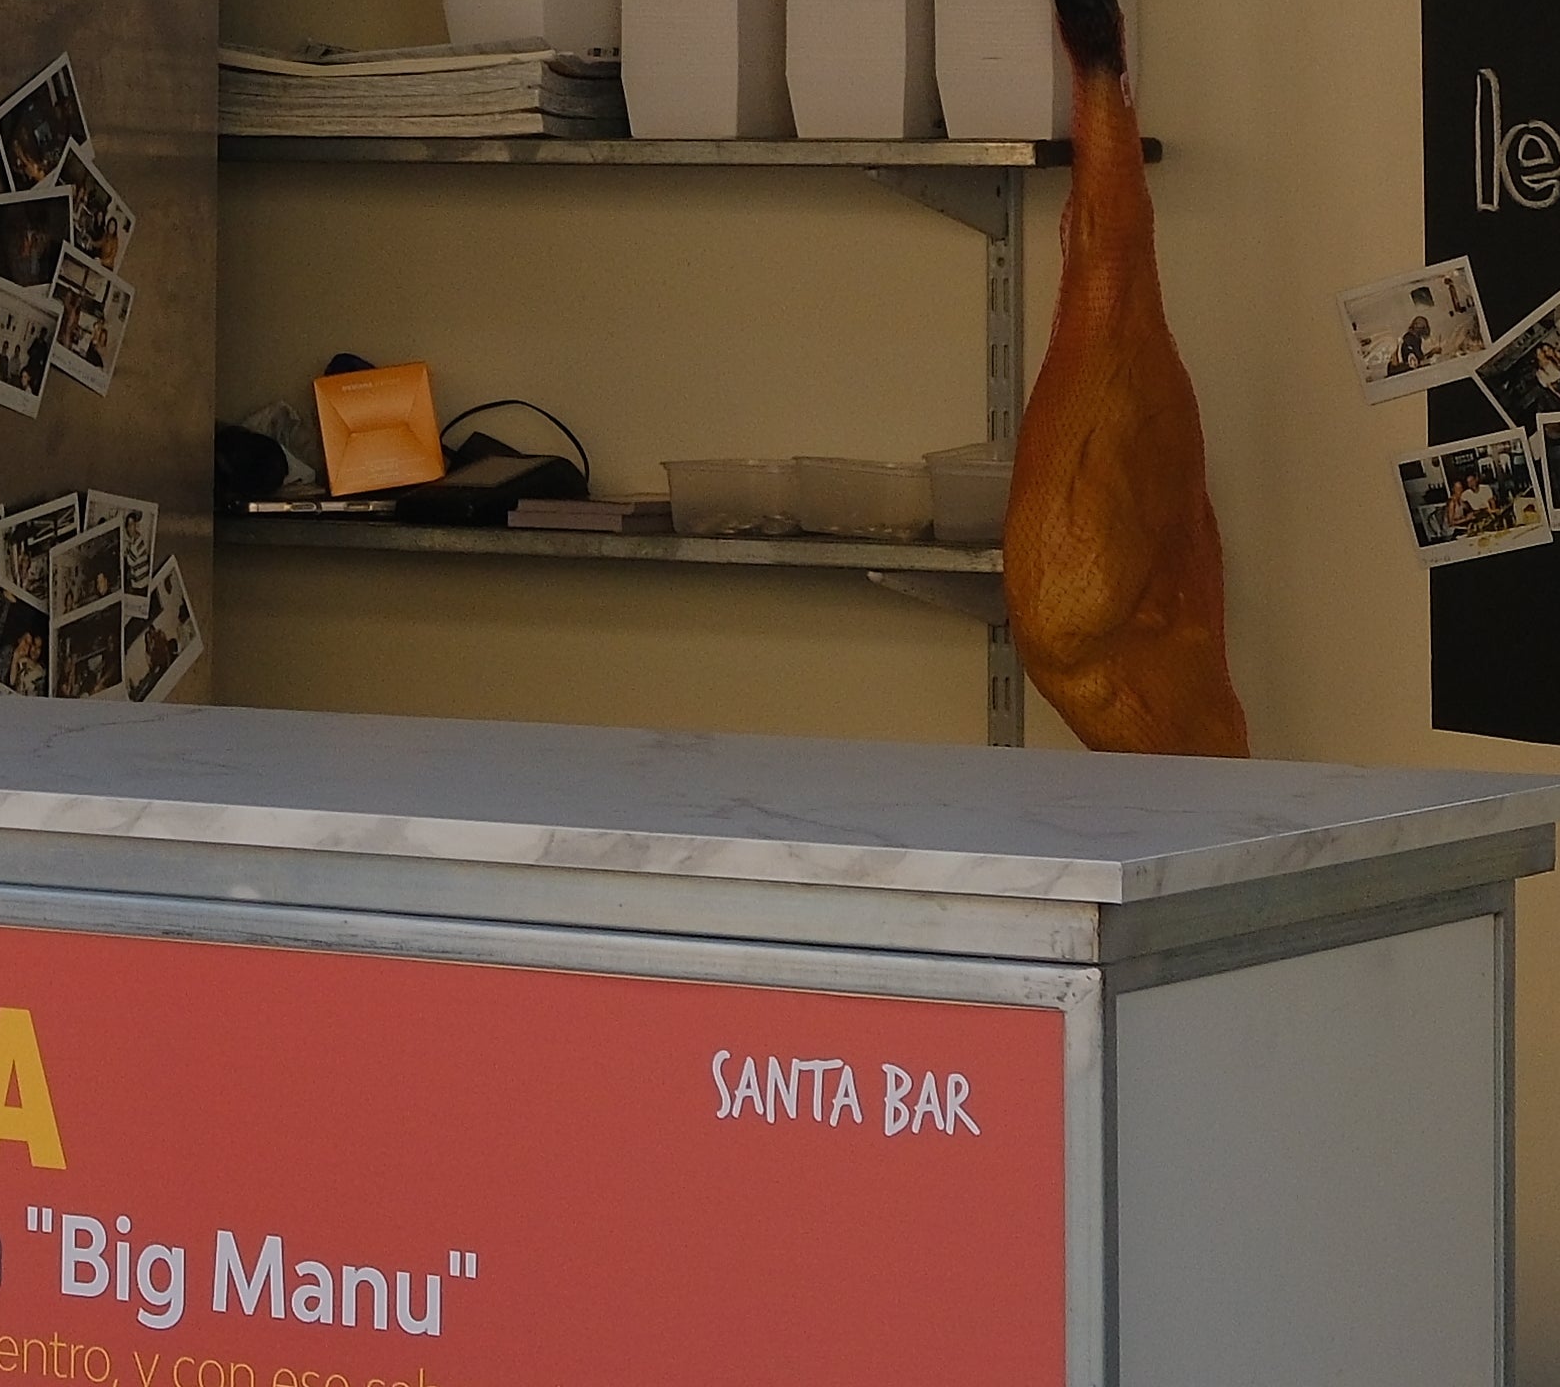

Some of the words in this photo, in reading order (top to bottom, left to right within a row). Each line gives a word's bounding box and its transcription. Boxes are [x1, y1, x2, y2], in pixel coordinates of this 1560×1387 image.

[712, 1050, 863, 1127] SANTA
[881, 1063, 981, 1136] BAR
[26, 1206, 185, 1329] "Big
[213, 1230, 478, 1336] Manu"
